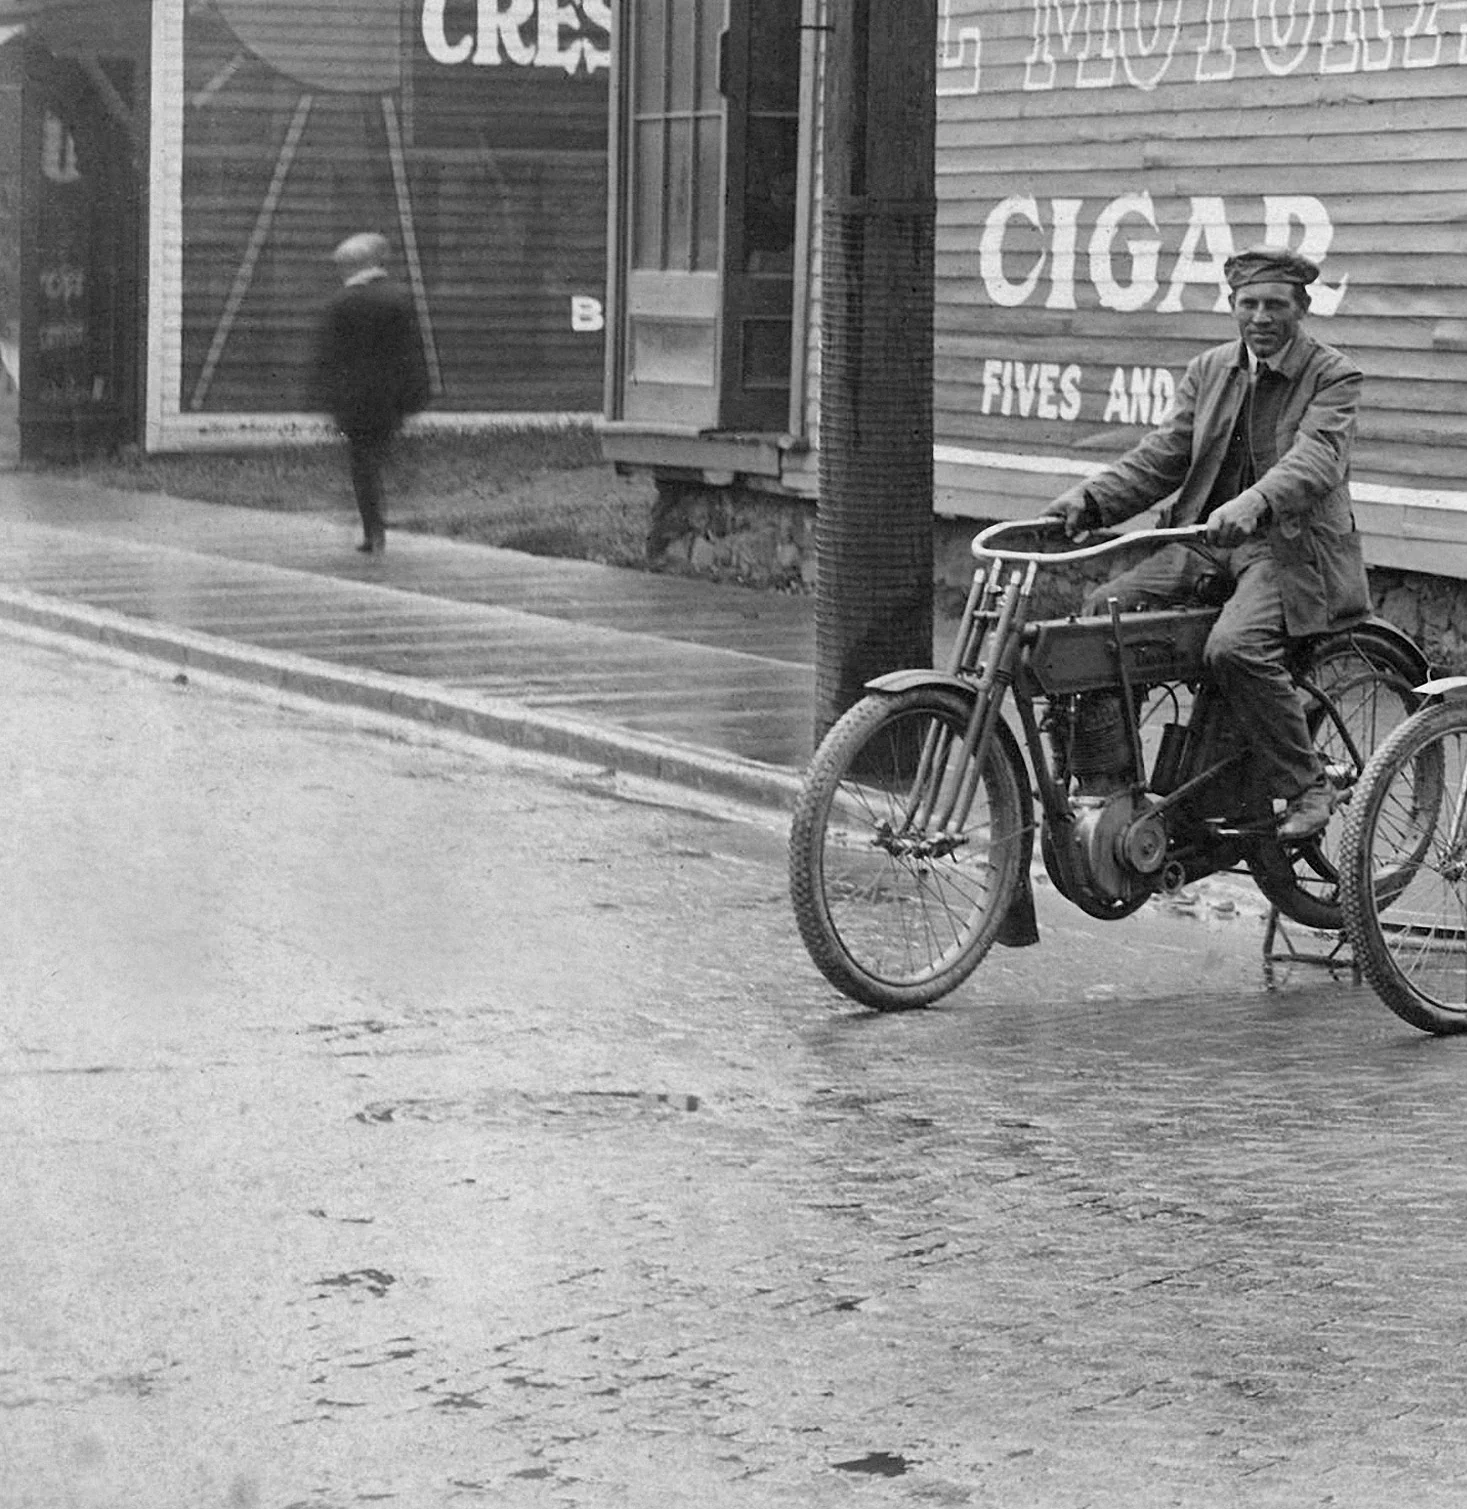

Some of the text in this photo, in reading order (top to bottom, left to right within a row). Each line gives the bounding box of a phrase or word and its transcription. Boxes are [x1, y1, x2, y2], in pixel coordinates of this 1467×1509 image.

[977, 189, 1350, 317] CIGAR
[981, 358, 1176, 426] FIVES AND
